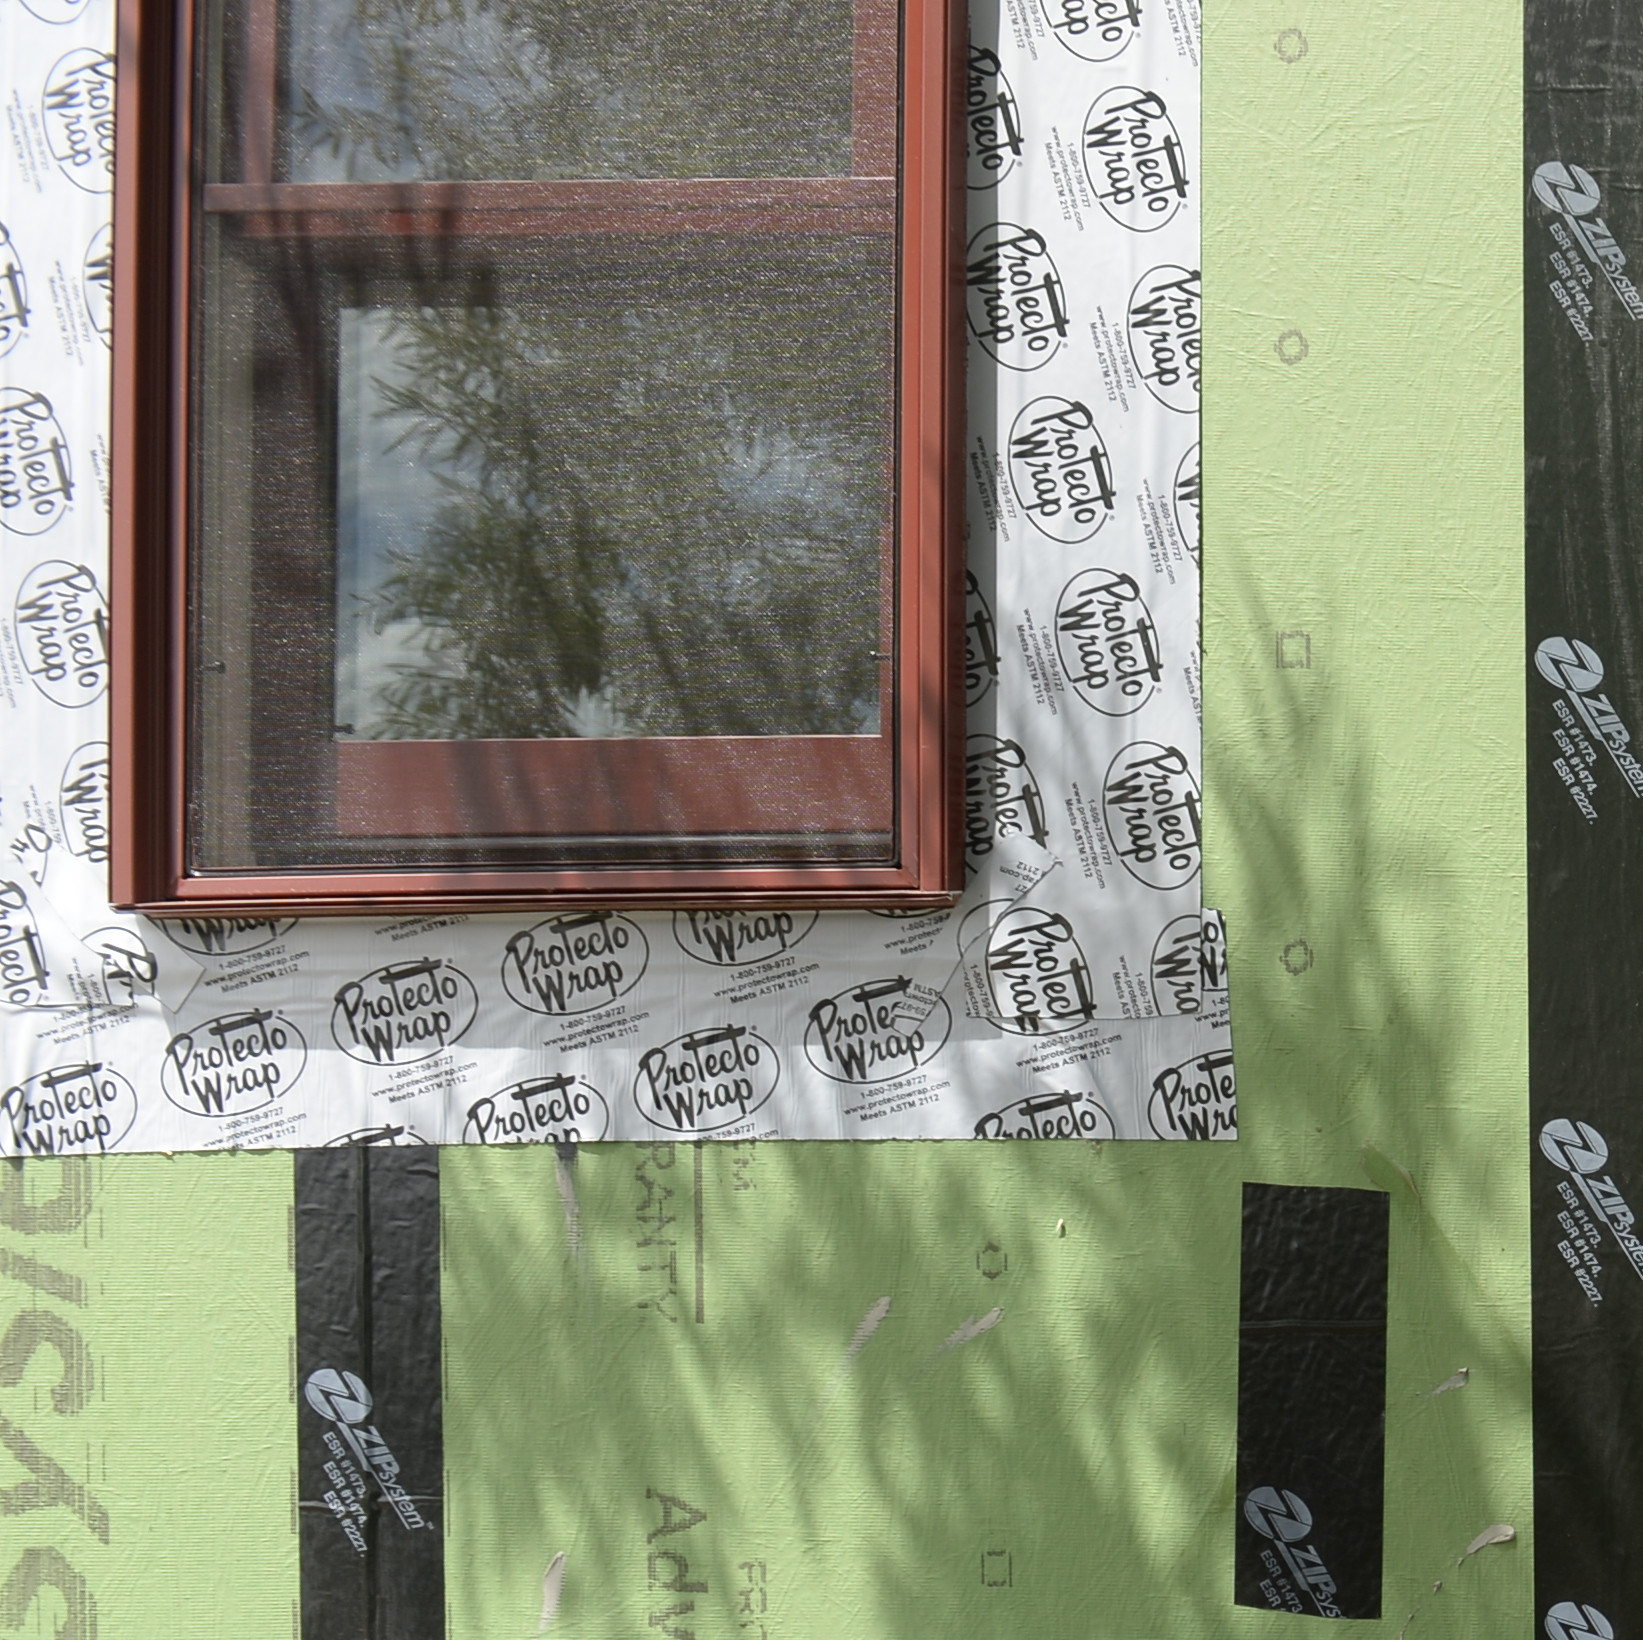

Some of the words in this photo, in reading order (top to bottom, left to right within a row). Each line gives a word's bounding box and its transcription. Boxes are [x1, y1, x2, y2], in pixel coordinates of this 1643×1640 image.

[46, 78, 92, 167] Wrap
[1053, 171, 1065, 197] ASTM
[1086, 116, 1135, 205] Wrap
[1098, 351, 1110, 377] ASTM
[1131, 296, 1180, 385] Wrap
[1013, 427, 1062, 516] Wrap
[18, 592, 67, 682] Wrap
[1059, 599, 1108, 688] Wrap
[1026, 654, 1038, 680] ASTM
[1552, 699, 1575, 728] ESR
[1570, 726, 1597, 767] #1473.
[1552, 729, 1575, 757] ESR
[1570, 755, 1598, 796] #1474.
[1552, 757, 1575, 787] ESR
[1570, 785, 1599, 825] #2227.
[1107, 773, 1156, 862] Wrap
[703, 911, 792, 962] Wrap
[532, 961, 621, 1012] Wrap
[760, 982, 785, 995] ASTM
[1008, 913, 1097, 1019] Protect
[361, 1011, 450, 1062] Wrap
[1062, 1053, 1087, 1066] ASTM
[191, 1062, 280, 1113] Wrap
[663, 1076, 752, 1127] Wrap
[891, 1100, 916, 1113] ASTM
[1557, 1181, 1580, 1210] ESR
[1575, 1208, 1602, 1249] #1473.
[1557, 1211, 1580, 1239] ESR
[1575, 1237, 1603, 1278] #1474.
[1557, 1239, 1580, 1269] ESR
[1575, 1267, 1604, 1307] #2227.
[323, 1431, 345, 1460] ESR
[323, 1461, 346, 1489] ESR
[323, 1490, 346, 1518] ESR
[1260, 1549, 1281, 1578] ESR
[1259, 1577, 1281, 1609] ESR
